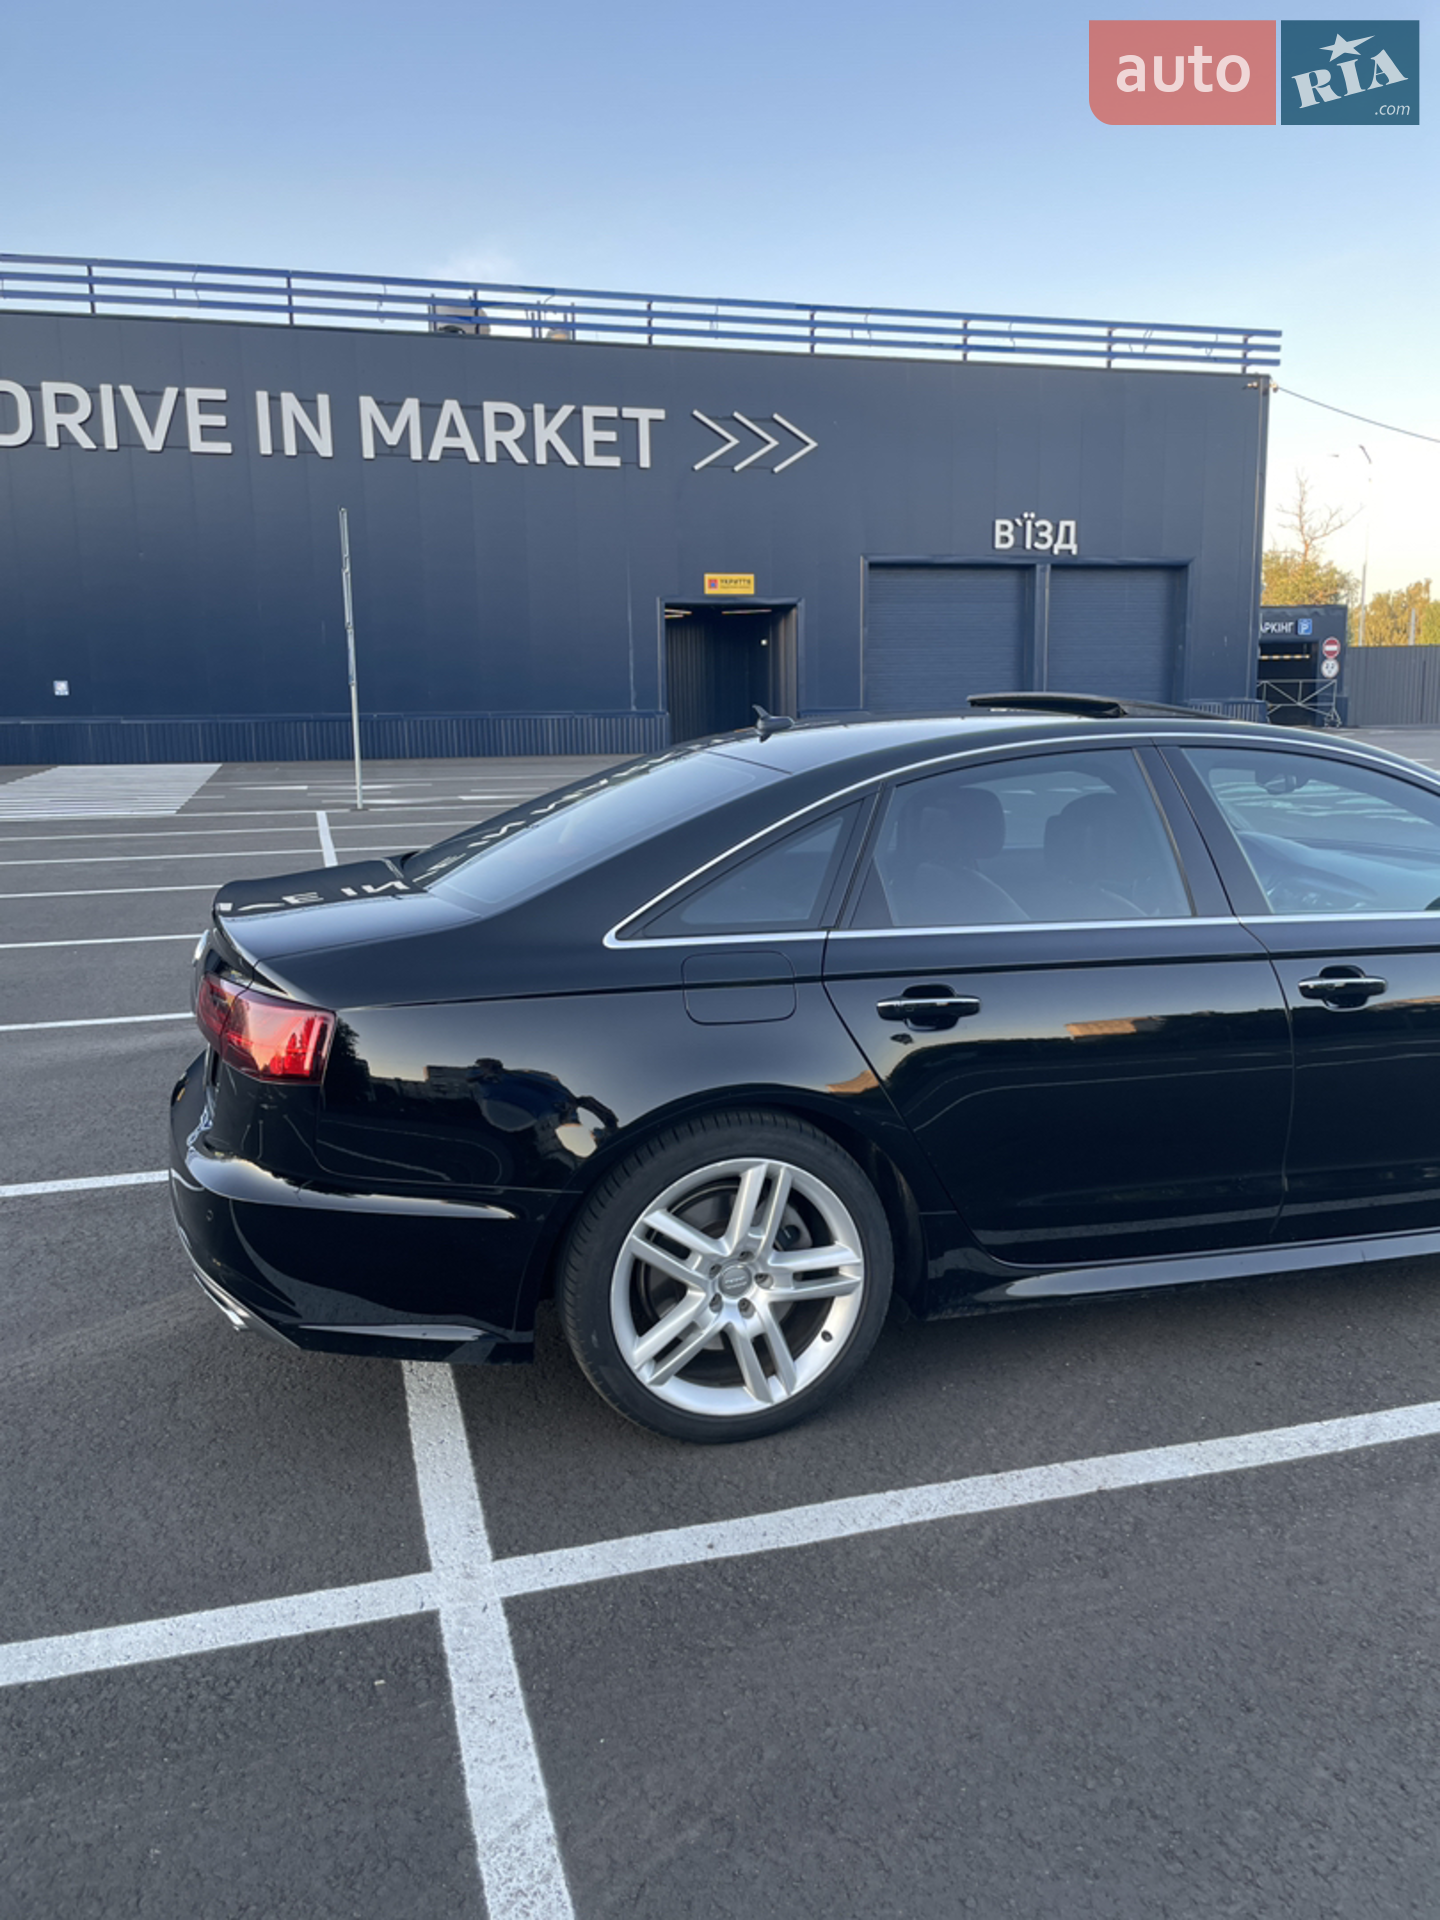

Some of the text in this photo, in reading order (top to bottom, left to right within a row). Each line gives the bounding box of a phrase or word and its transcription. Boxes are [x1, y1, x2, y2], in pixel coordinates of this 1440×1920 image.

[0, 380, 667, 469] DRIVE IN MARKET
